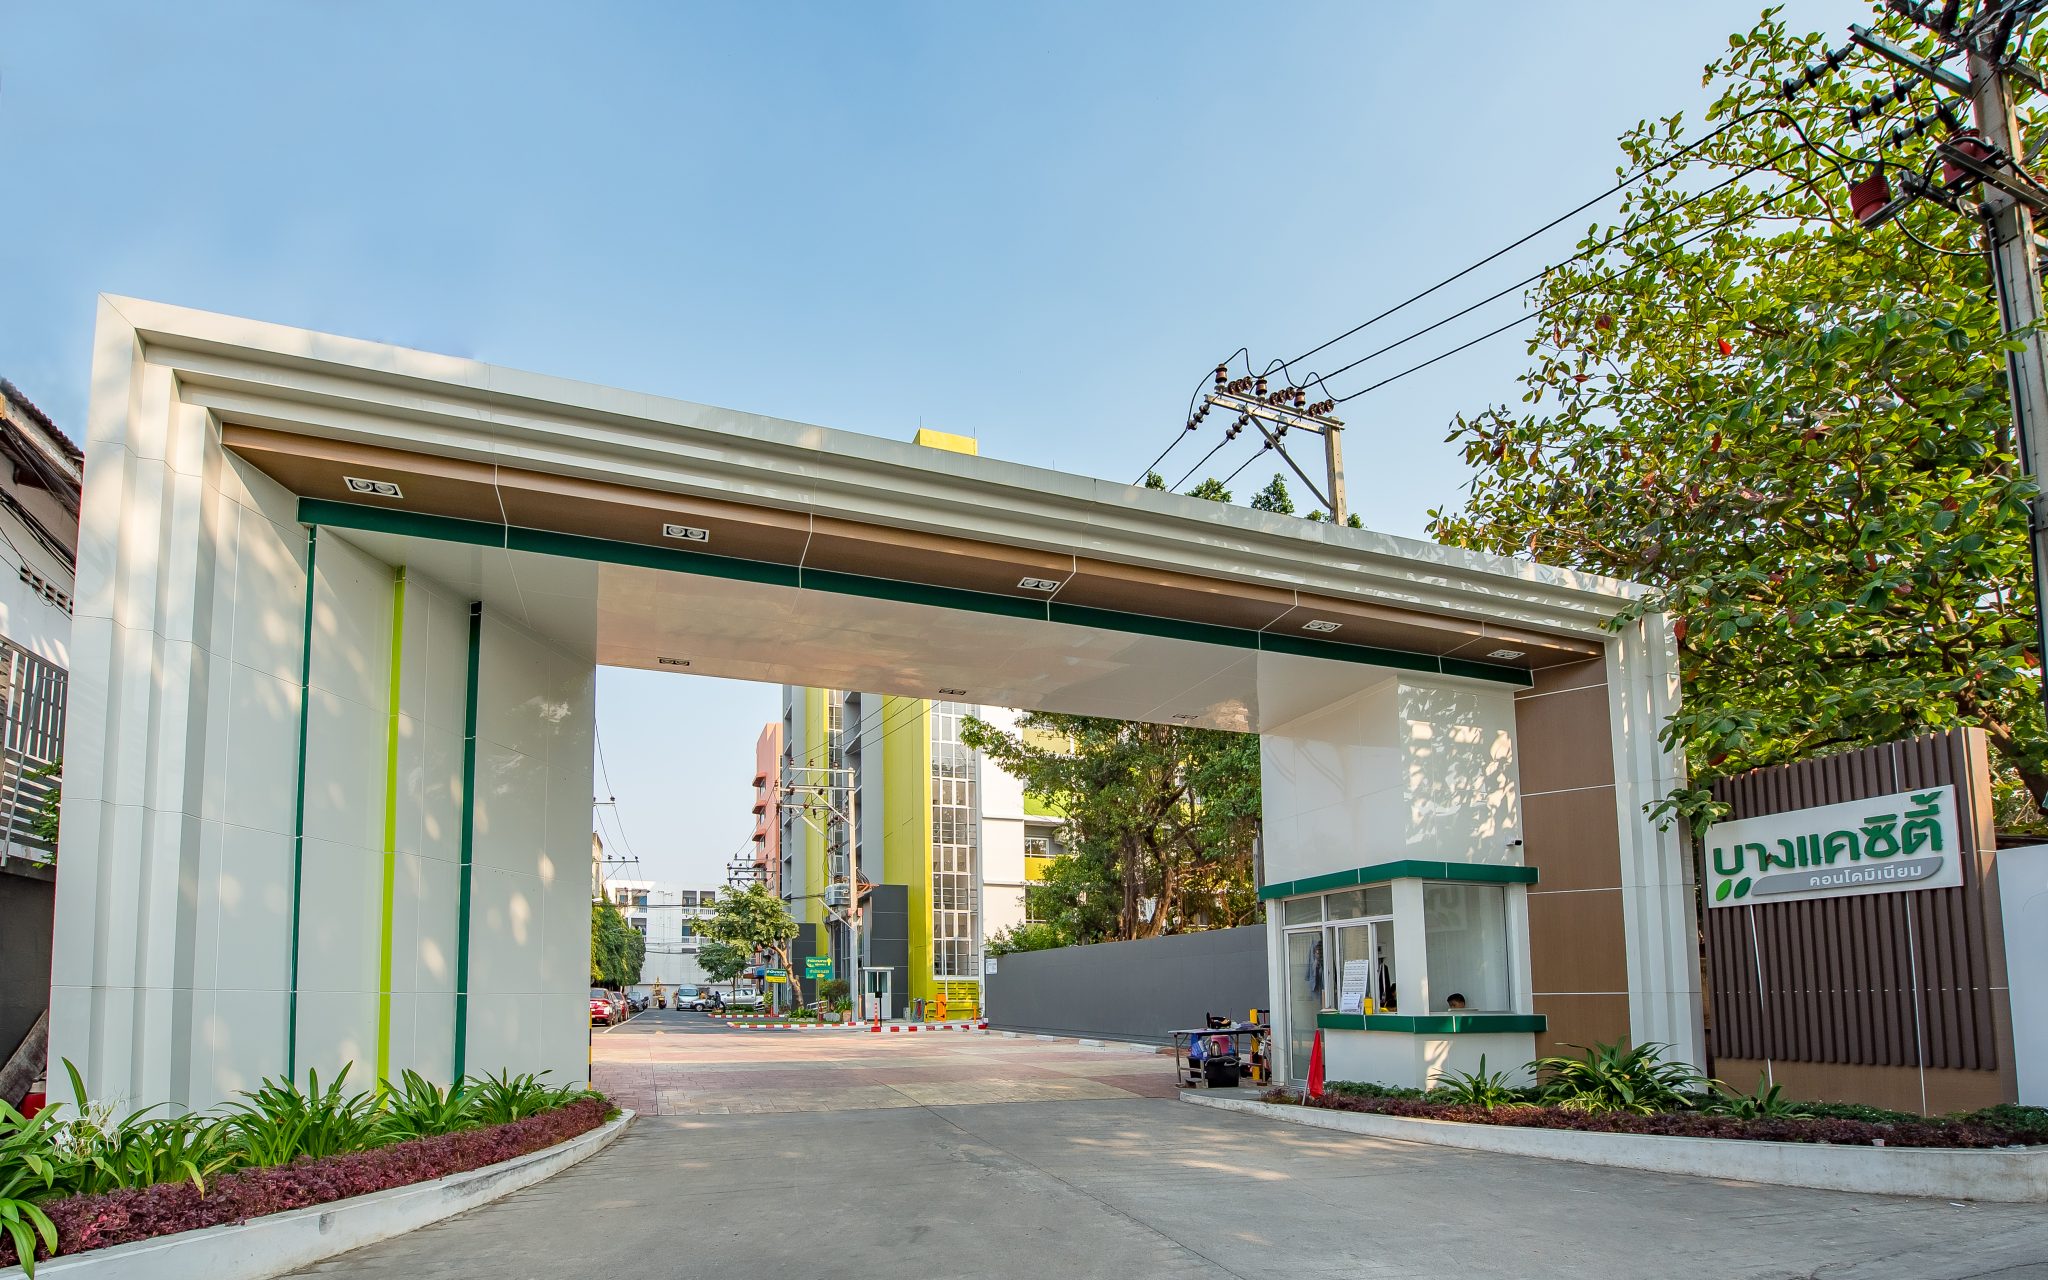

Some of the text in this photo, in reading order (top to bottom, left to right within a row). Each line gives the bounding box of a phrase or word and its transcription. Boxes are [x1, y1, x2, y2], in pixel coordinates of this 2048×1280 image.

[1713, 790, 1943, 875] บางแคซิตี้
[1809, 864, 1922, 886] คอนโดมิเนียม
